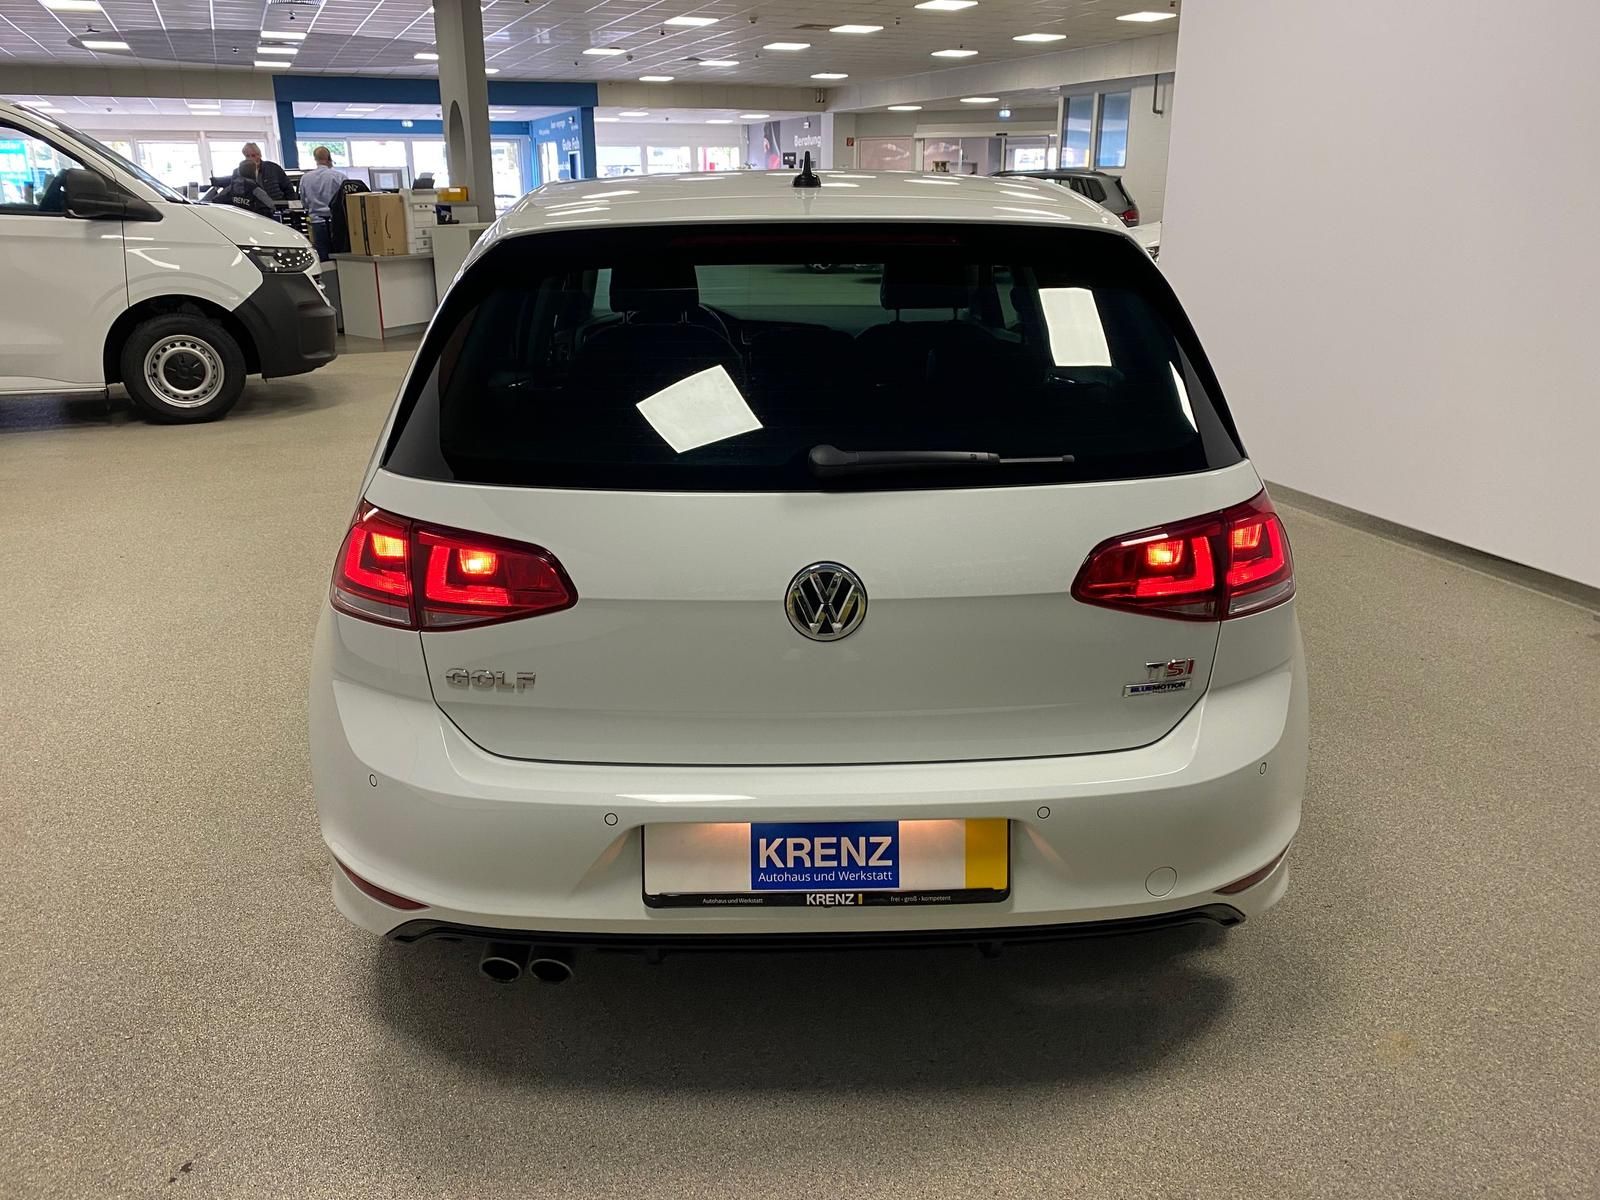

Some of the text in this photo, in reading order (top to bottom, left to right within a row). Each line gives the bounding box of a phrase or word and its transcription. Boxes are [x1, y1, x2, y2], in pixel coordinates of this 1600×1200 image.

[233, 196, 250, 206] RENZ
[1145, 658, 1194, 681] TSI
[446, 668, 536, 692] GOLF
[1130, 682, 1186, 693] BLUEMOTION
[759, 836, 893, 869] KRENZ
[758, 870, 893, 883] Autohaus und Werkstatt
[806, 893, 855, 905] KRENZ
